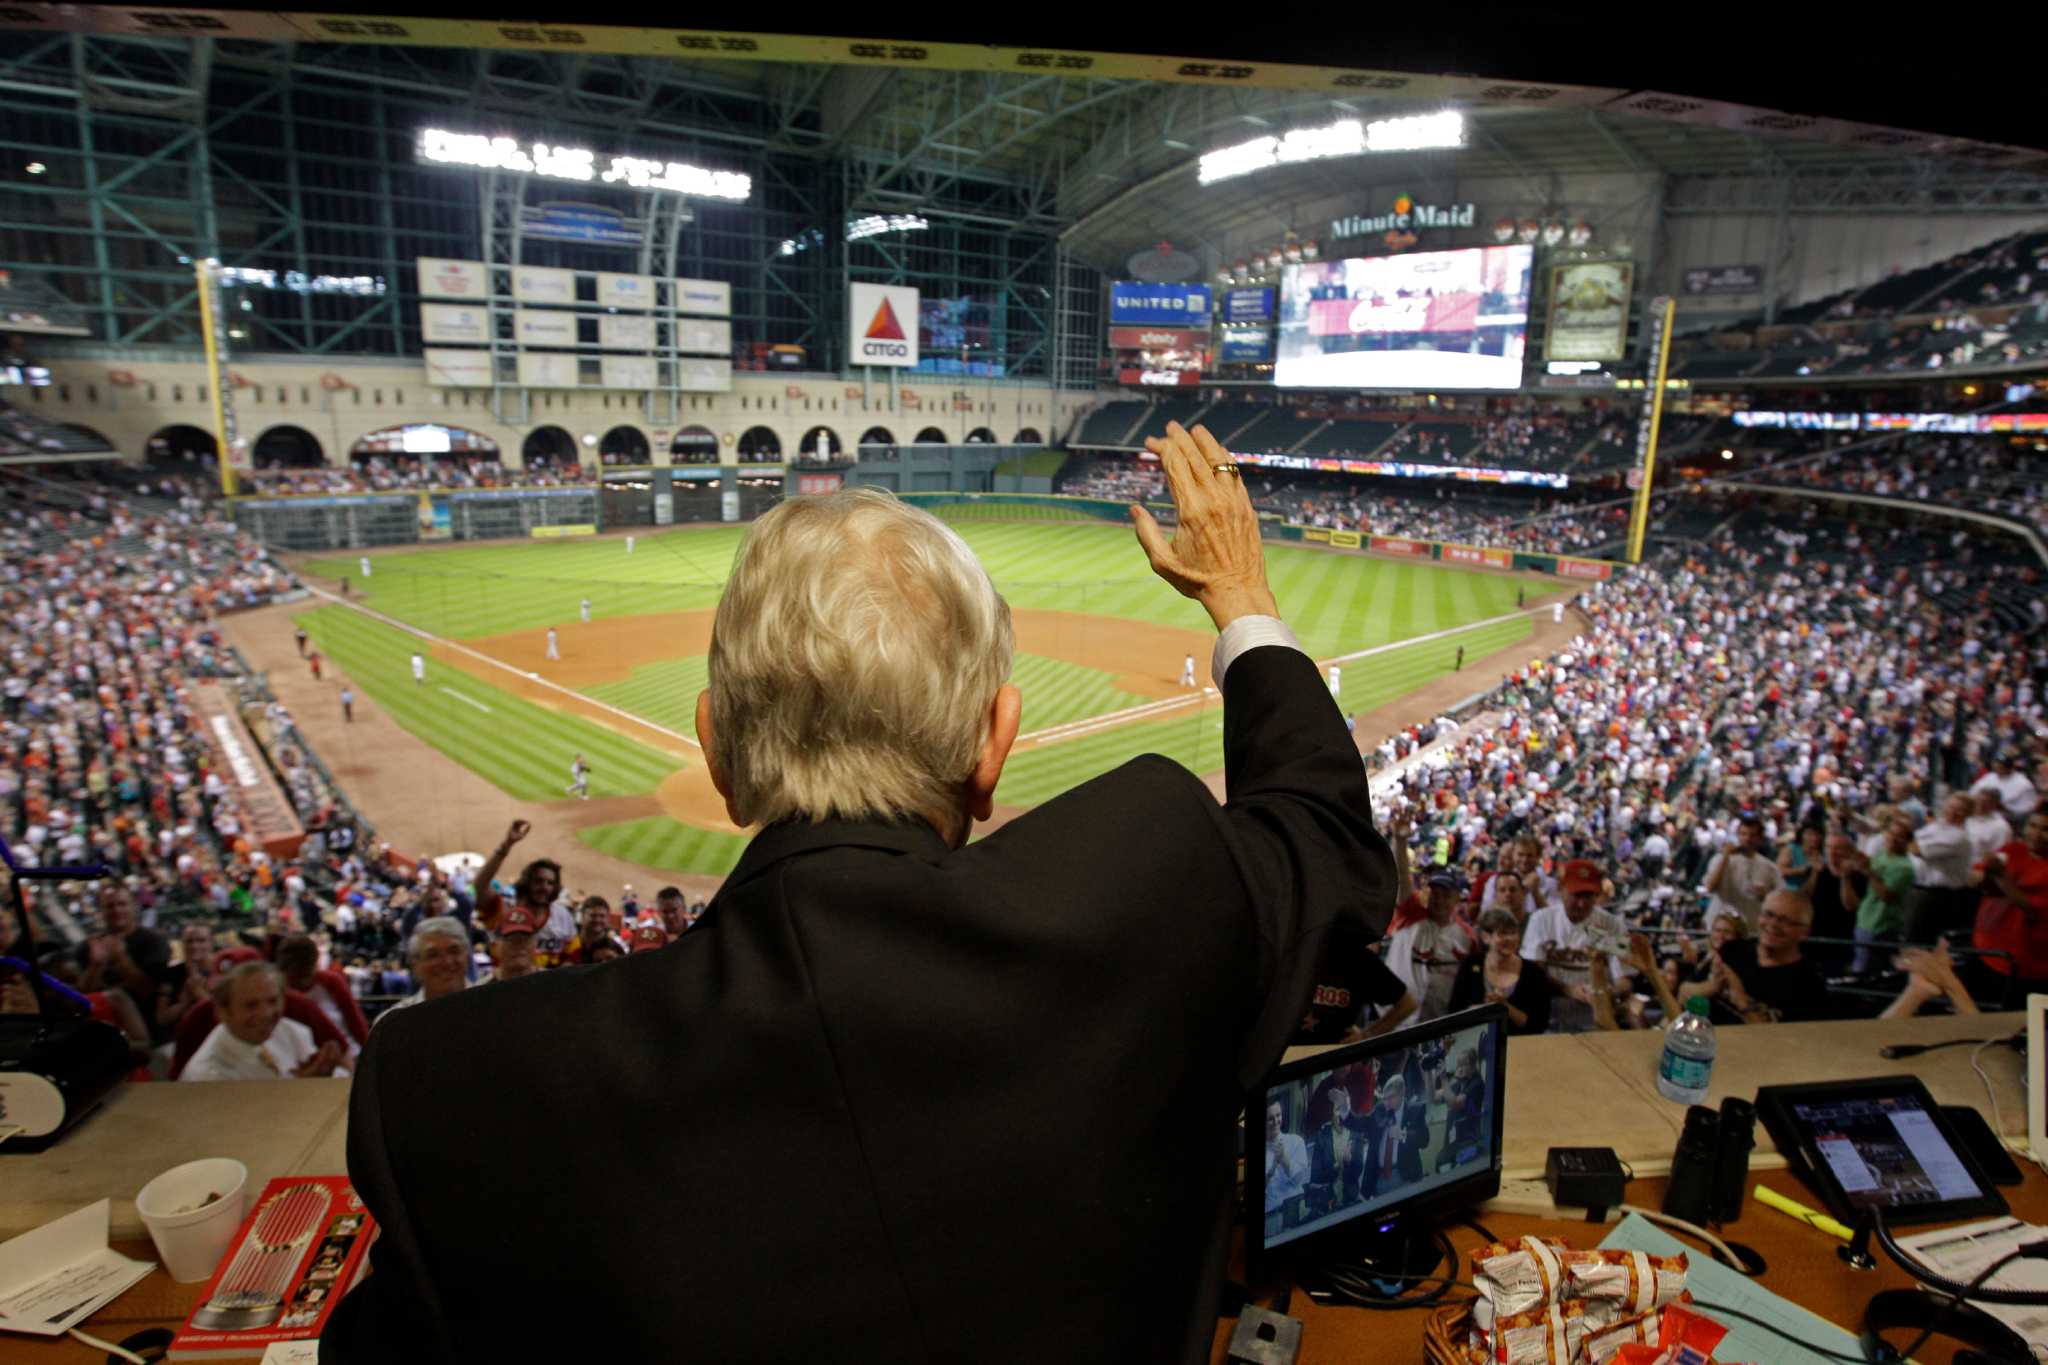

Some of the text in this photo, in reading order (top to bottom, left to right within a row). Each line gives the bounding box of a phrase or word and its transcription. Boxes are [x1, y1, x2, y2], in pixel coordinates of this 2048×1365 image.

[1331, 203, 1475, 239] Minute Maid
[1117, 296, 1185, 310] UNITED
[863, 343, 908, 357] CITGO
